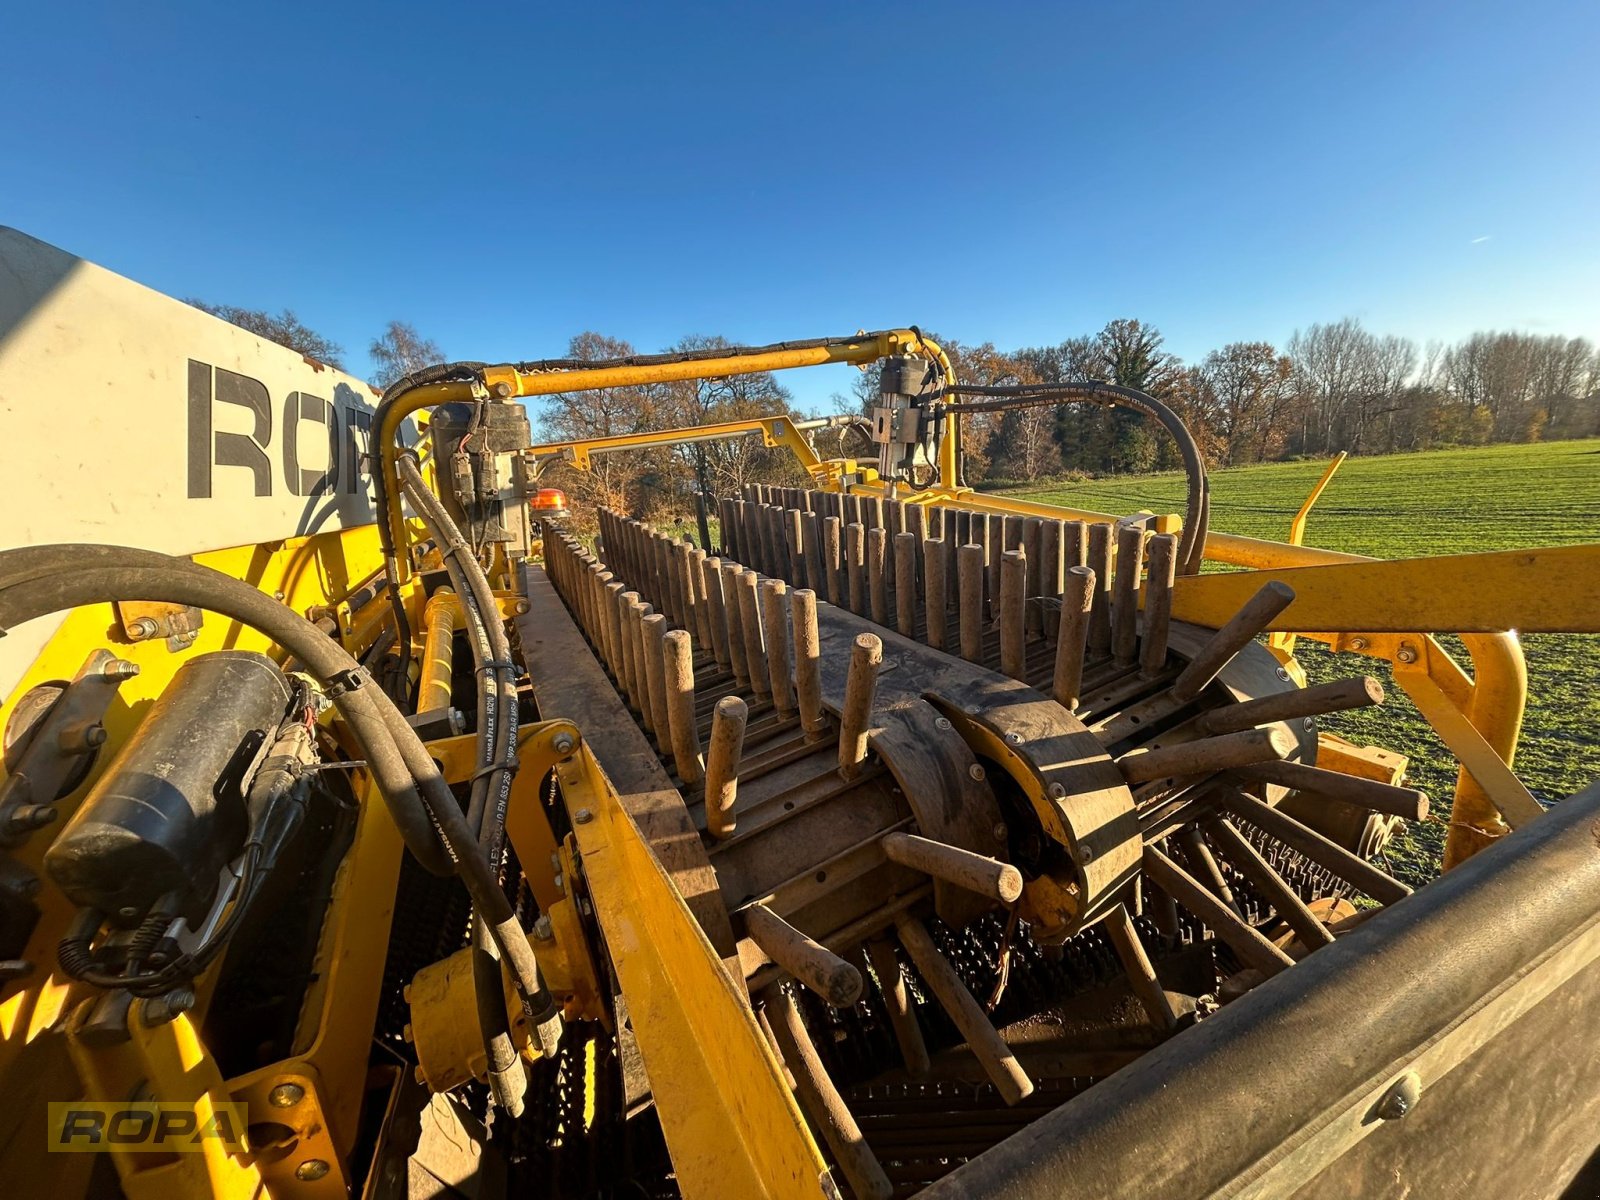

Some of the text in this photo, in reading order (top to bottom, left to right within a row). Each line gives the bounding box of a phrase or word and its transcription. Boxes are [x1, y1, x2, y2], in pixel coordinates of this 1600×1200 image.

[188, 358, 403, 498] ROP
[509, 718, 517, 733] BAR
[509, 733, 517, 746] 330
[507, 746, 515, 758] WP
[499, 785, 509, 800] 853
[498, 799, 506, 813] EN
